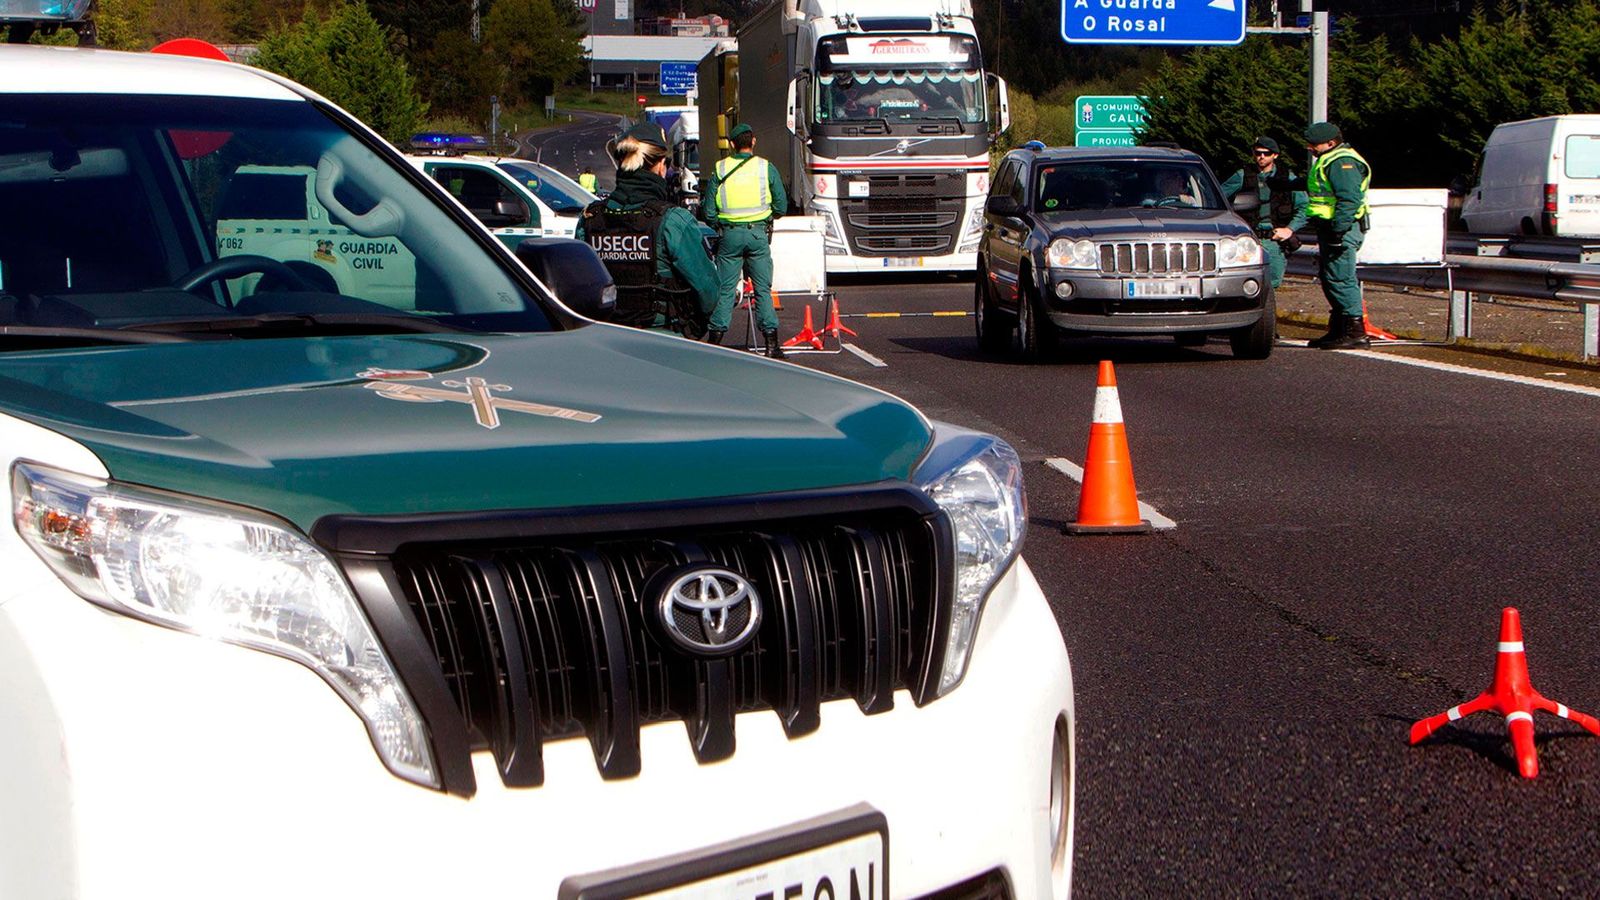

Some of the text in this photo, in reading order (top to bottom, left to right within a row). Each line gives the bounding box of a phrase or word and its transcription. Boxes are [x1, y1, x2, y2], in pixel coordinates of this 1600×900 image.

[1083, 16, 1165, 32] O Rosal
[227, 238, 243, 249] 062
[339, 242, 398, 255] GUARDIA
[592, 235, 650, 252] USECIC
[597, 252, 650, 260] UARDIA CIVIL
[353, 257, 384, 270] CIVIL
